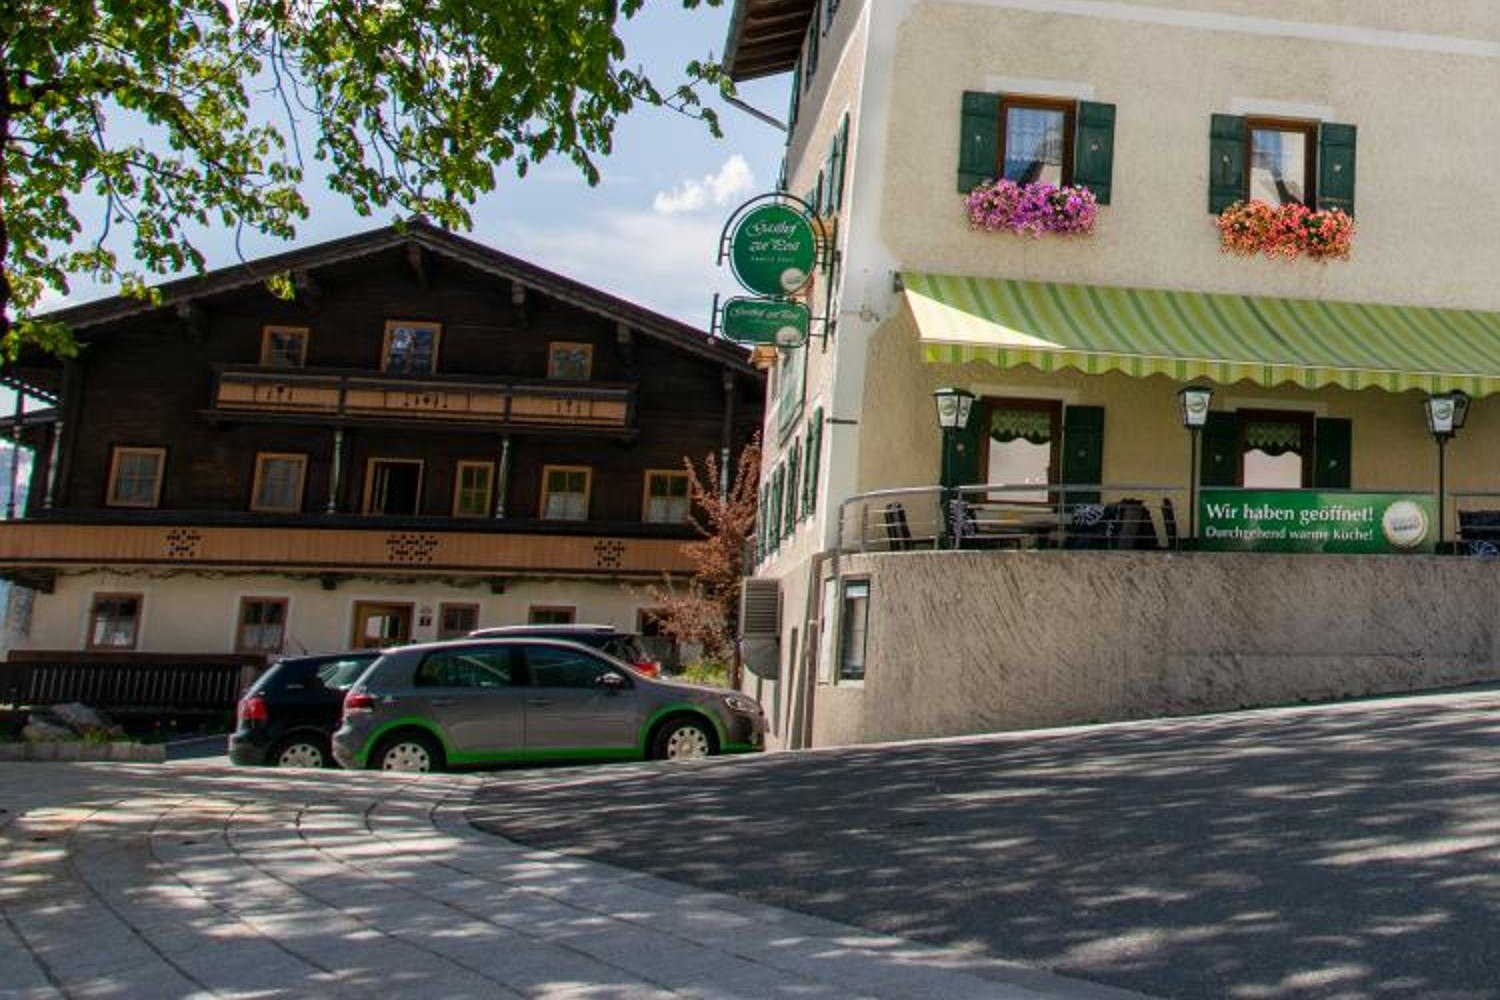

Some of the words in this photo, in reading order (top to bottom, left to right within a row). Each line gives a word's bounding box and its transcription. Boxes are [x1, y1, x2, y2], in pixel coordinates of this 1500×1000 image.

[1206, 503, 1238, 520] Wir
[1243, 503, 1295, 521] haben
[1299, 504, 1374, 526] geöffnet!
[1289, 529, 1330, 541] warme
[1333, 527, 1374, 541] Küche!
